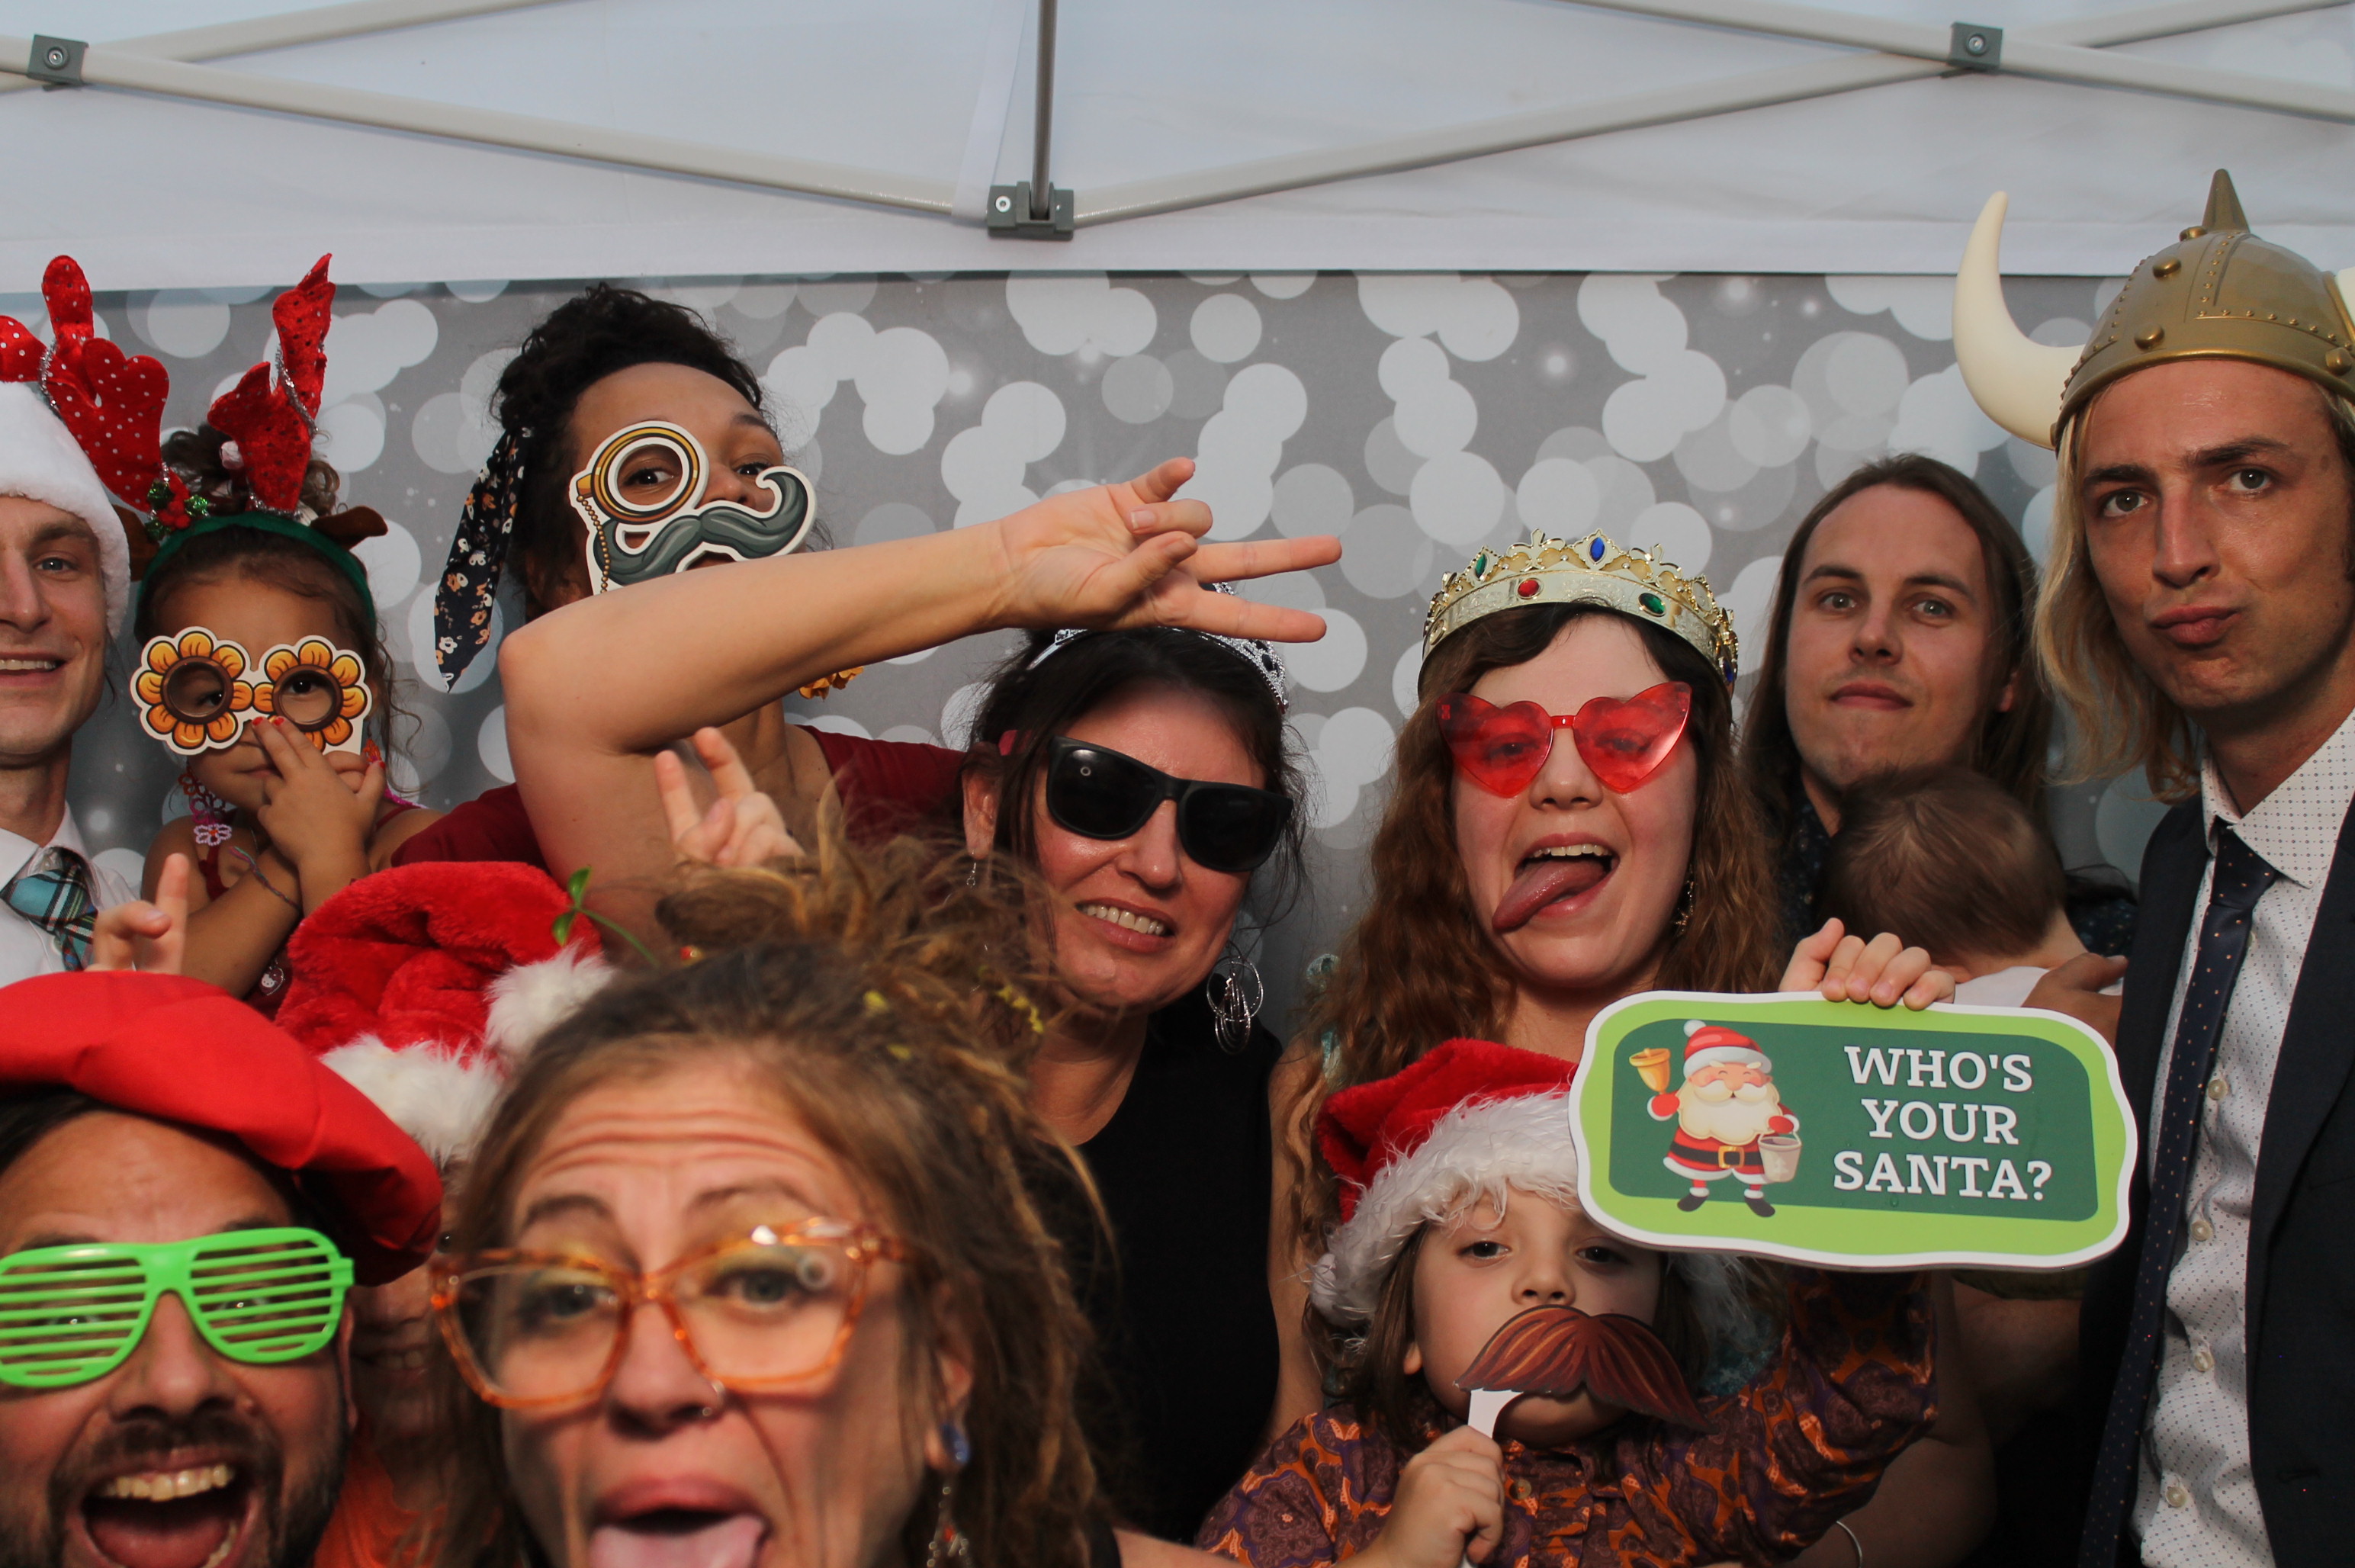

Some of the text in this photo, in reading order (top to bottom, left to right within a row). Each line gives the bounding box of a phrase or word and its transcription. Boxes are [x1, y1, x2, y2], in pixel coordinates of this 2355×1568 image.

[1844, 1046, 2033, 1092] WHO'S
[1861, 1098, 2019, 1145] YOUR
[1833, 1151, 2052, 1201] SANTA?
